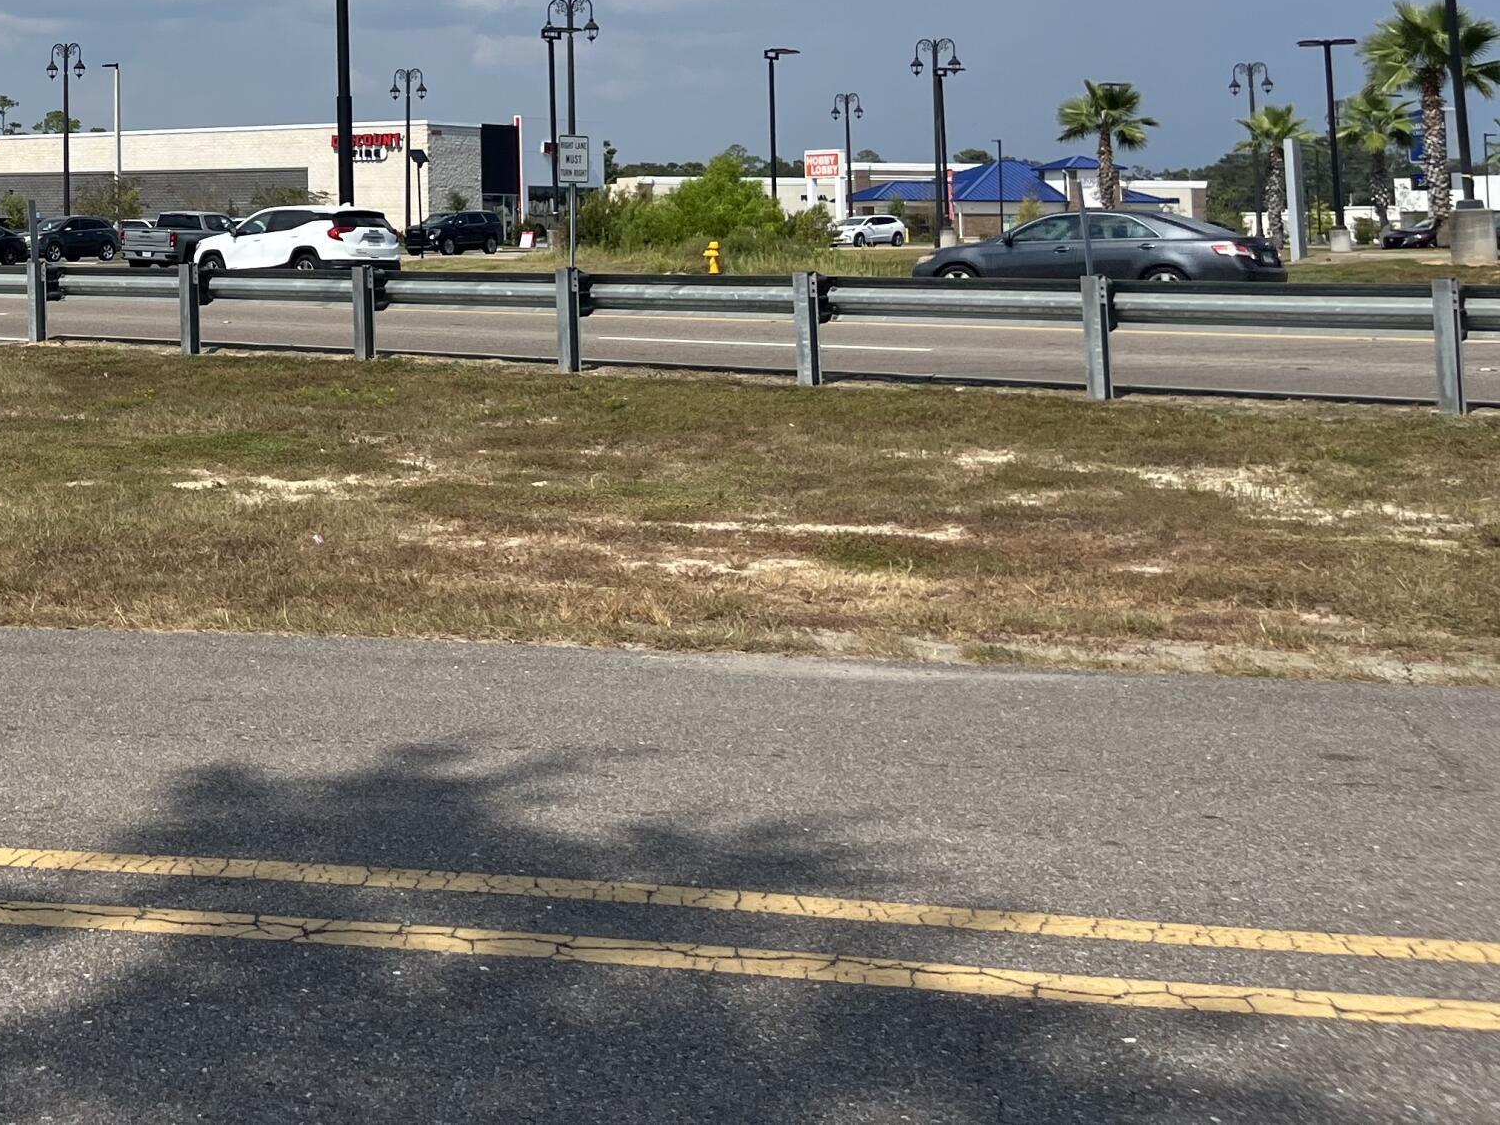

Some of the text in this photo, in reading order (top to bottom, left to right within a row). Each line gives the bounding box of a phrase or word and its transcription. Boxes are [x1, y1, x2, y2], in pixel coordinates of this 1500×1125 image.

[566, 154, 582, 164] MUST
[806, 155, 835, 164] HOBBY
[811, 164, 838, 175] LOBBY
